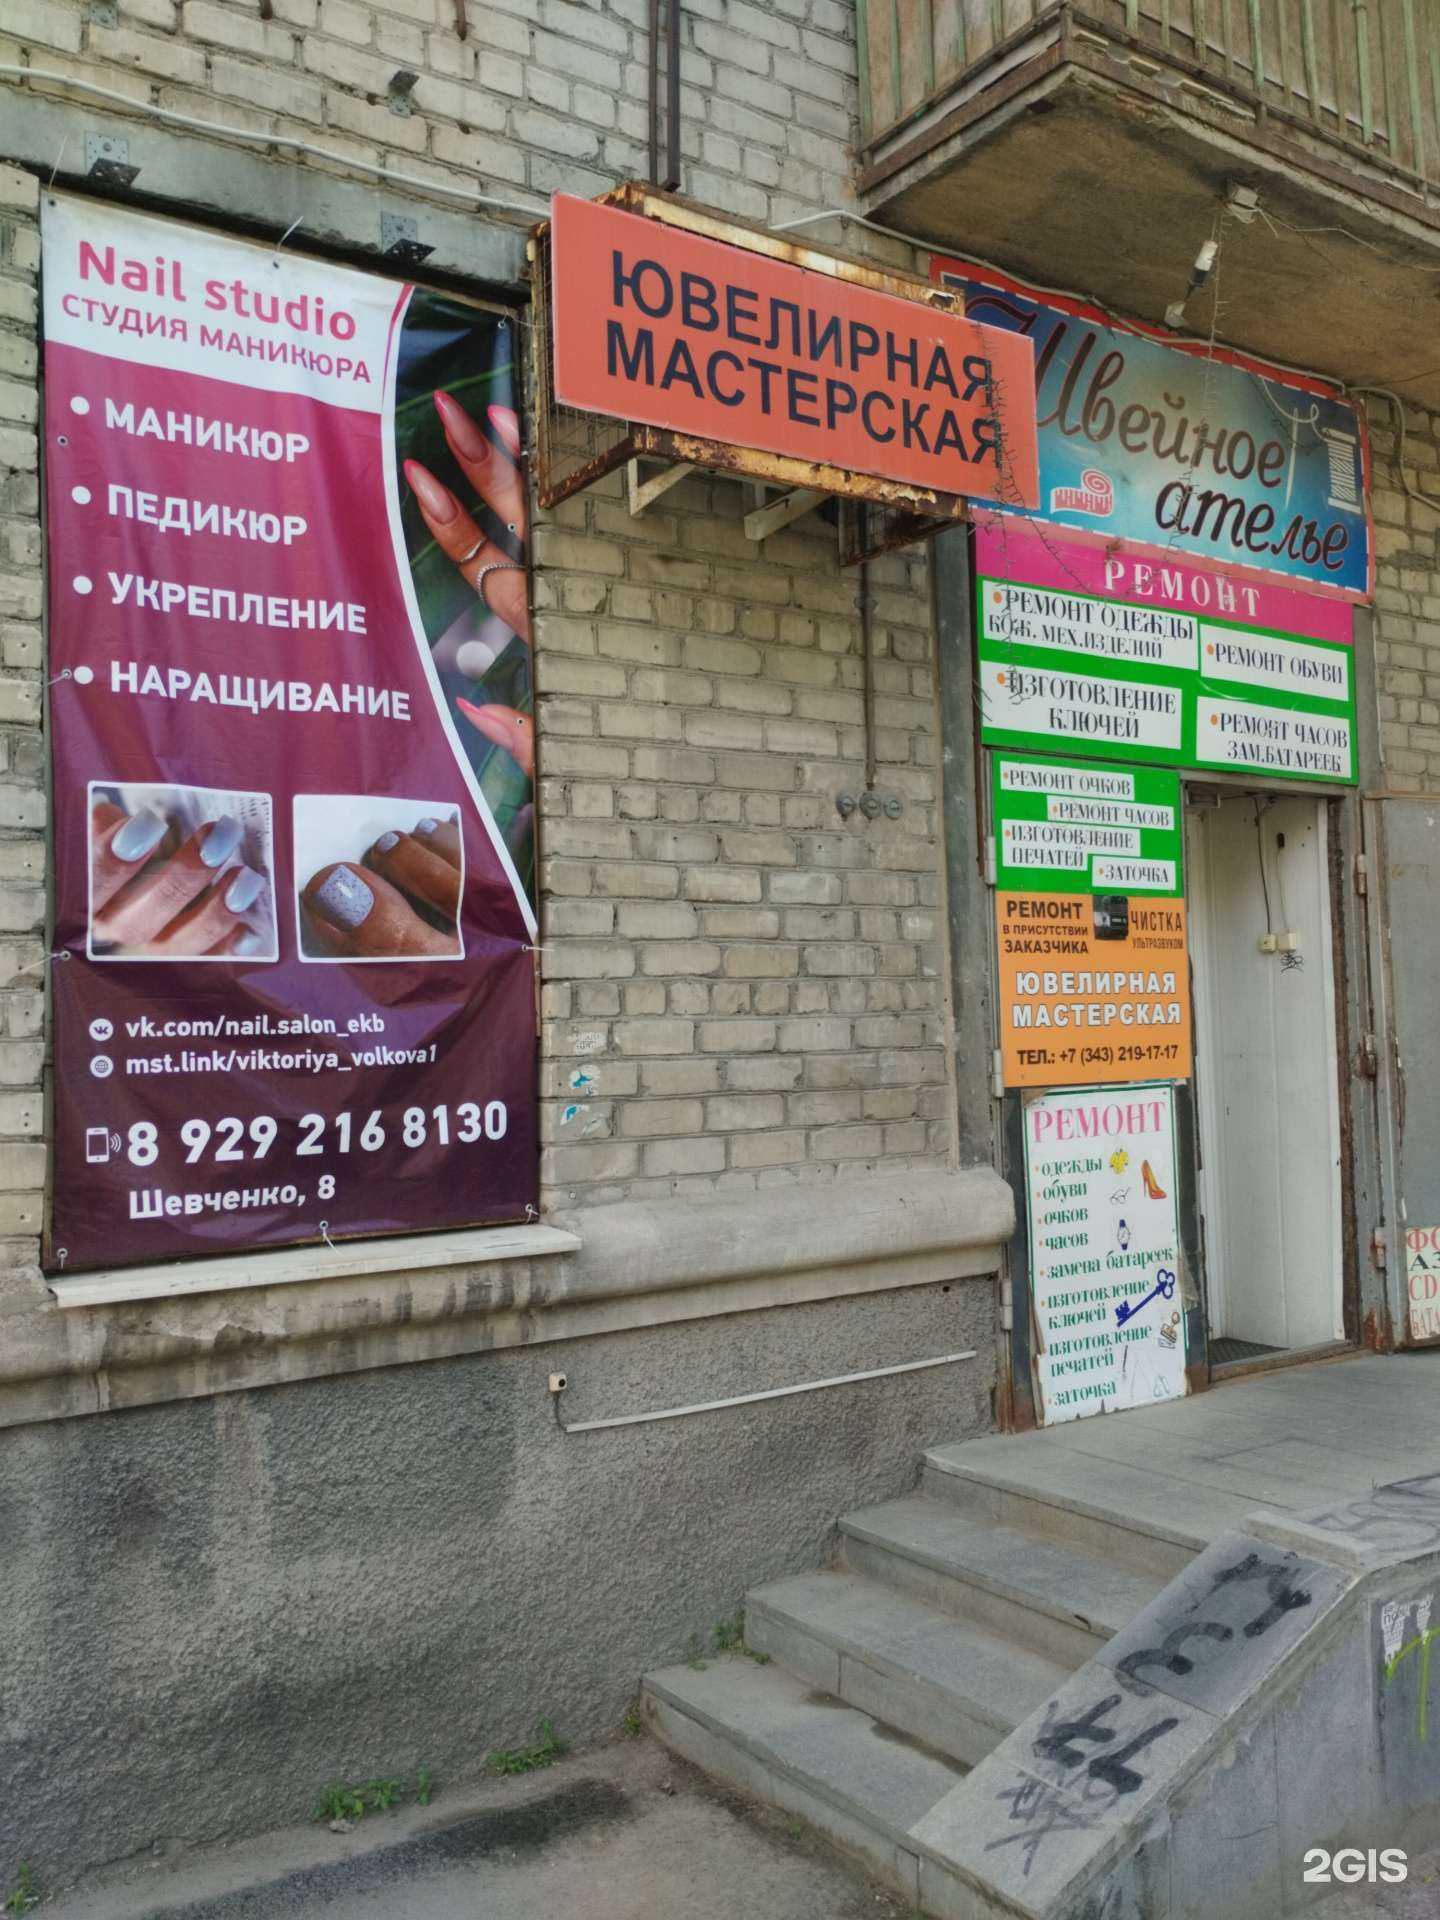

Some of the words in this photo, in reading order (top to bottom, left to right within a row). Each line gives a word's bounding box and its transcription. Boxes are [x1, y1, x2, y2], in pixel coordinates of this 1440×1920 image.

[78, 240, 187, 302] Nail
[204, 278, 357, 342] studio
[61, 293, 188, 343] СТУДИЯ
[200, 324, 371, 384] МАНИКЮРА
[612, 249, 992, 406] ЮВЕЛИРНАЯ
[606, 320, 1003, 468] МАСТЕРСКАЯ
[105, 398, 311, 464] МАНИКЮР
[107, 484, 308, 546] ПЕДИКЮР
[1155, 481, 1350, 570] ателье
[1103, 559, 1261, 617] РЕМОНТ
[108, 572, 367, 635] УКРЕПЛЕНИЕ
[1005, 589, 1095, 624] РЕМОНТ
[1101, 606, 1193, 641] ОДЕЖДЫ
[1215, 642, 1286, 675] РЕМОНТ
[1289, 658, 1344, 685] ОБУВИ
[110, 660, 411, 721] НАРАЩИВАНИЕ
[1008, 671, 1176, 714] ИЗГОТОВЛЕНИЕ
[1049, 707, 1140, 740] КЛЮЧЕЙ
[1220, 712, 1289, 740] РЕМОНТ
[1294, 723, 1347, 748] ЧАСОВ
[1010, 769, 1075, 790] РЕМОНТ
[1079, 775, 1131, 796] ОЧКОВ
[1058, 802, 1121, 821] РЕМОНТ
[1124, 808, 1169, 826] ЧАСОВ
[1011, 824, 1134, 849] ИЗГОТОВЛЕНИЕ
[1012, 846, 1084, 867] ПЕЧАТЕЙ
[1105, 864, 1169, 883] ЗАТОЧКА
[1006, 900, 1083, 920] РЕМОНТ
[1131, 910, 1183, 932] ЧИСТКА
[1002, 925, 1010, 935] В
[1013, 924, 1088, 936] ПРИСУТСТВИИ
[1004, 939, 1089, 954] ЗАКАЗЧИКА
[1016, 971, 1176, 995] ЮВЕЛИРНАЯ
[125, 1013, 385, 1039] vk.com/nail.salon_ekb
[1013, 1002, 1182, 1028] МАСТЕРСКАЯ
[126, 1044, 436, 1075] mst.link/viktoriya_volkova1
[1017, 1049, 1056, 1065] ТЕЛ.:
[1059, 1048, 1076, 1064] +7
[1080, 1046, 1114, 1066] (343)
[1118, 1045, 1178, 1062] 219-17-17
[127, 1121, 159, 1166] 8
[180, 1115, 278, 1164] 929
[296, 1110, 386, 1156] 216
[402, 1100, 508, 1148] 8130
[1032, 1101, 1166, 1143] РЕМОНТ
[1042, 1157, 1102, 1177] одежды
[128, 1182, 306, 1220] Шевченко,
[317, 1174, 336, 1200] 8
[1043, 1179, 1087, 1203] обуви
[1044, 1208, 1089, 1226] очков
[1045, 1232, 1089, 1250] часов
[1047, 1258, 1100, 1279] замена
[1105, 1248, 1173, 1270] батареек
[1048, 1279, 1150, 1309] изготовление
[1049, 1303, 1107, 1330] ключей
[1049, 1325, 1152, 1357] изготовление
[1051, 1348, 1115, 1378] печатей
[1054, 1380, 1117, 1407] заточка
